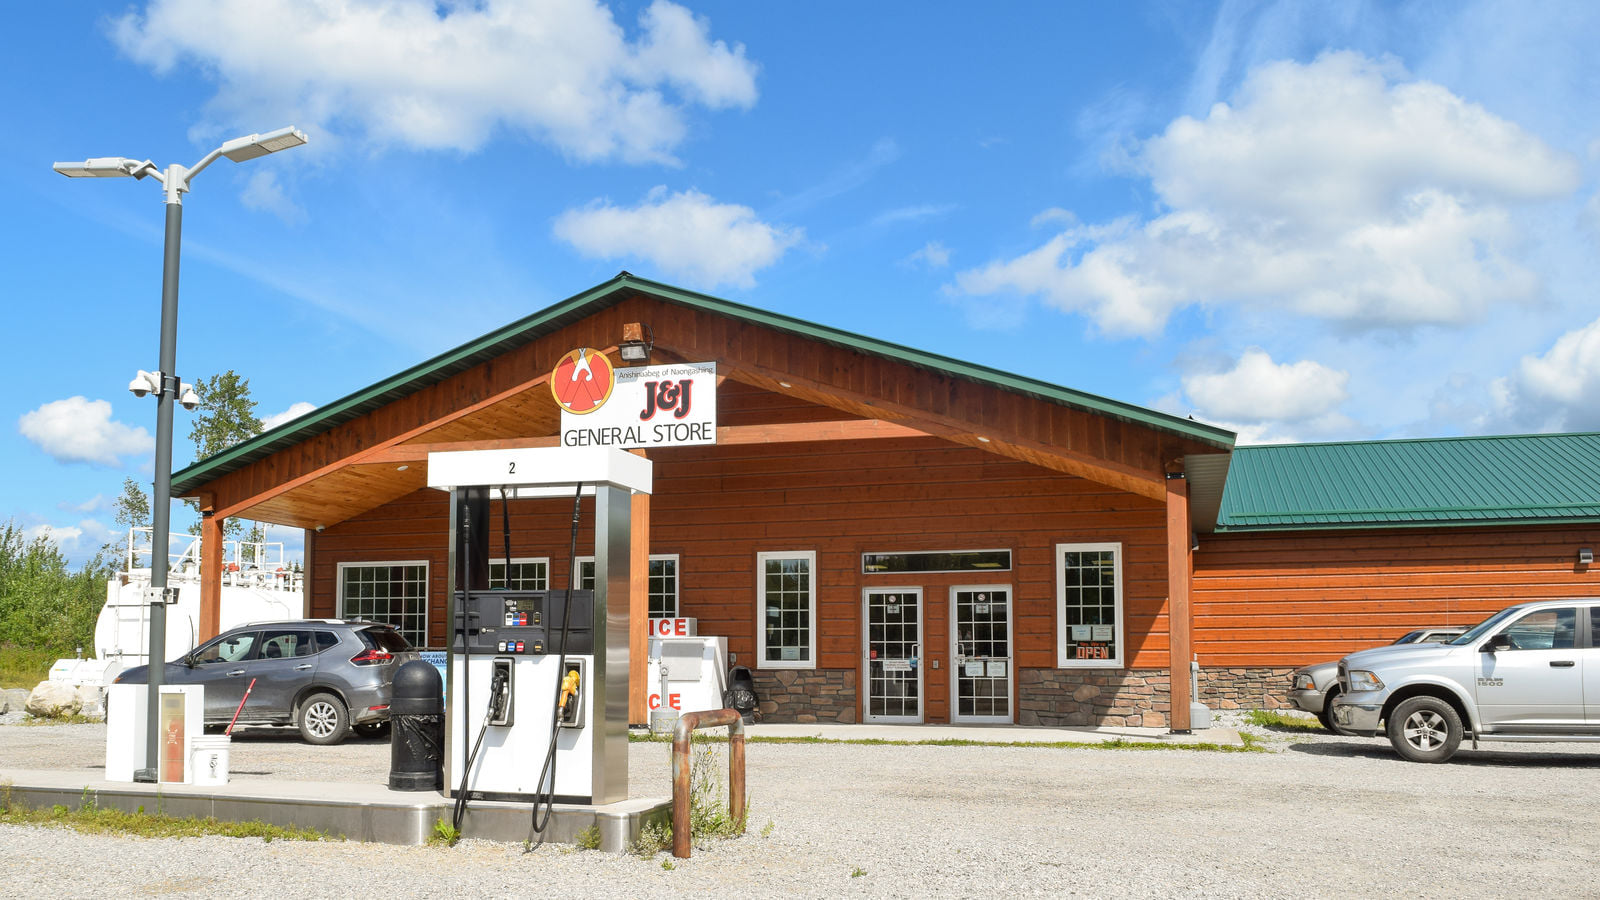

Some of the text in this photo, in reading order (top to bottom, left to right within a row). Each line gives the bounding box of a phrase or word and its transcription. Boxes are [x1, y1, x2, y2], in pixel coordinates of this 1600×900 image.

[639, 379, 694, 421] J&J
[564, 421, 713, 447] GENERAL STORE
[508, 461, 516, 474] 2
[649, 618, 686, 636] ICE
[1076, 646, 1109, 659] OPEN
